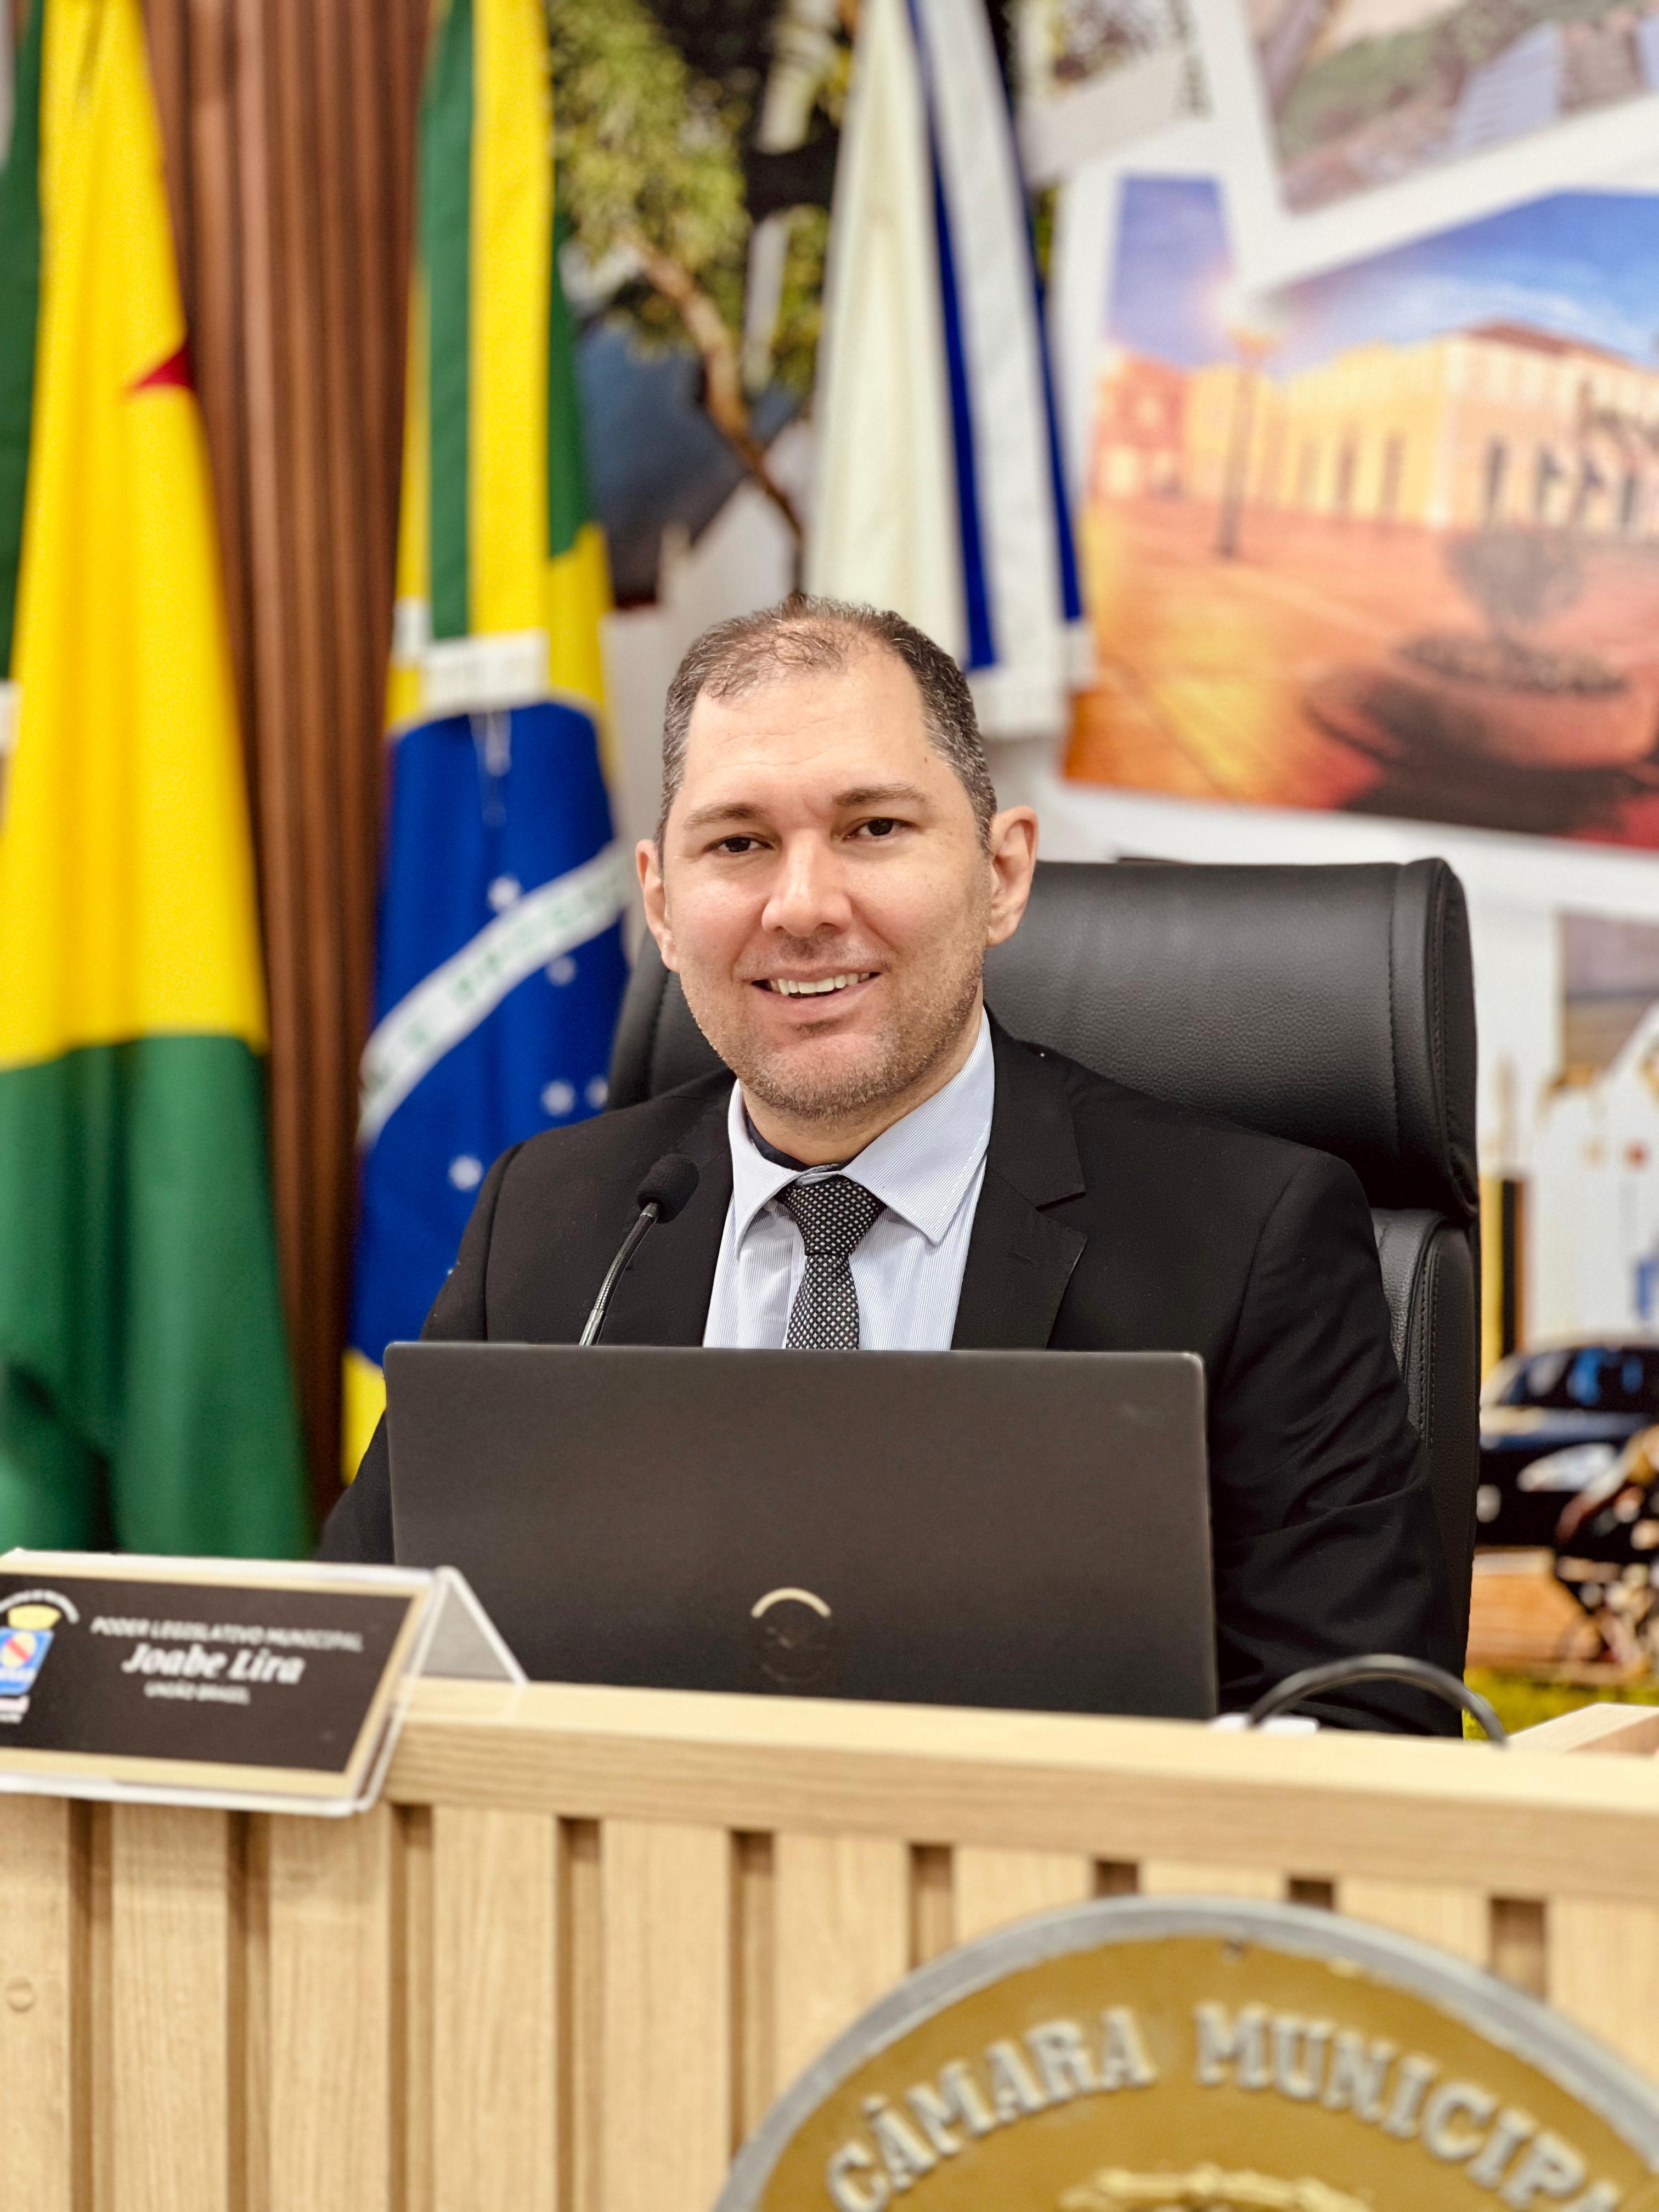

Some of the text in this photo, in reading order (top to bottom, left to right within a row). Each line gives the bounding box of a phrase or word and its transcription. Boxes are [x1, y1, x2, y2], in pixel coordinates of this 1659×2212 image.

[121, 1643, 306, 1684] Joabe Lira
[828, 2006, 1156, 2212] CÂMARA
